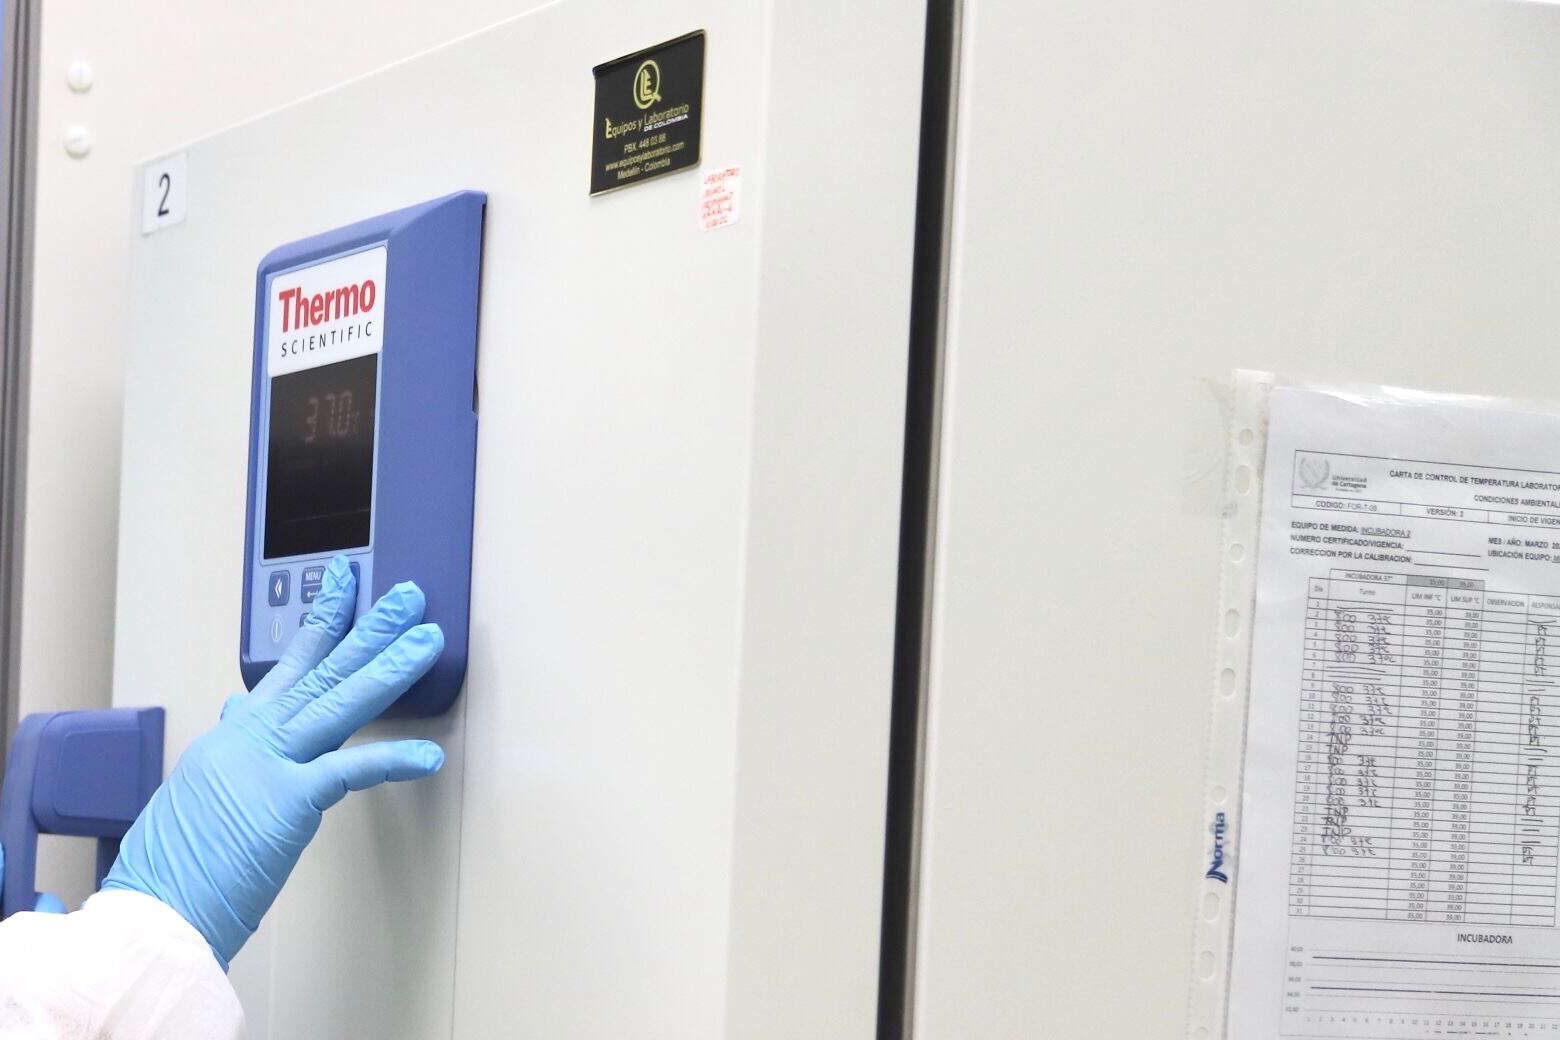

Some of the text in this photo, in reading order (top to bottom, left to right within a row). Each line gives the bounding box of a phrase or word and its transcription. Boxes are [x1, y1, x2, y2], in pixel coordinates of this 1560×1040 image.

[605, 104, 689, 139] Equipos y Laboratorio
[158, 173, 170, 218] 2
[279, 280, 375, 333] Thermo
[281, 321, 372, 357] SCIENTIFIC
[1389, 470, 1412, 479] CARTA
[1414, 472, 1423, 480] DE
[1425, 473, 1458, 483] CONTROL
[1460, 476, 1468, 484] DE
[1470, 477, 1520, 488] TEMPERATURA
[1474, 494, 1519, 505] CONDICIONES
[1530, 516, 1538, 524] DE
[1291, 521, 1318, 530] EQUIPO
[1320, 523, 1329, 531] DE
[1331, 524, 1359, 533] MEDIDA:
[1360, 526, 1406, 537] INCUBADORA
[1525, 541, 1549, 549] MARZO
[1338, 551, 1352, 559] POR
[1354, 552, 1363, 560] LA
[305, 571, 322, 581] MENU
[1206, 812, 1228, 884] Norma
[1457, 933, 1513, 944] INCUBADORA
